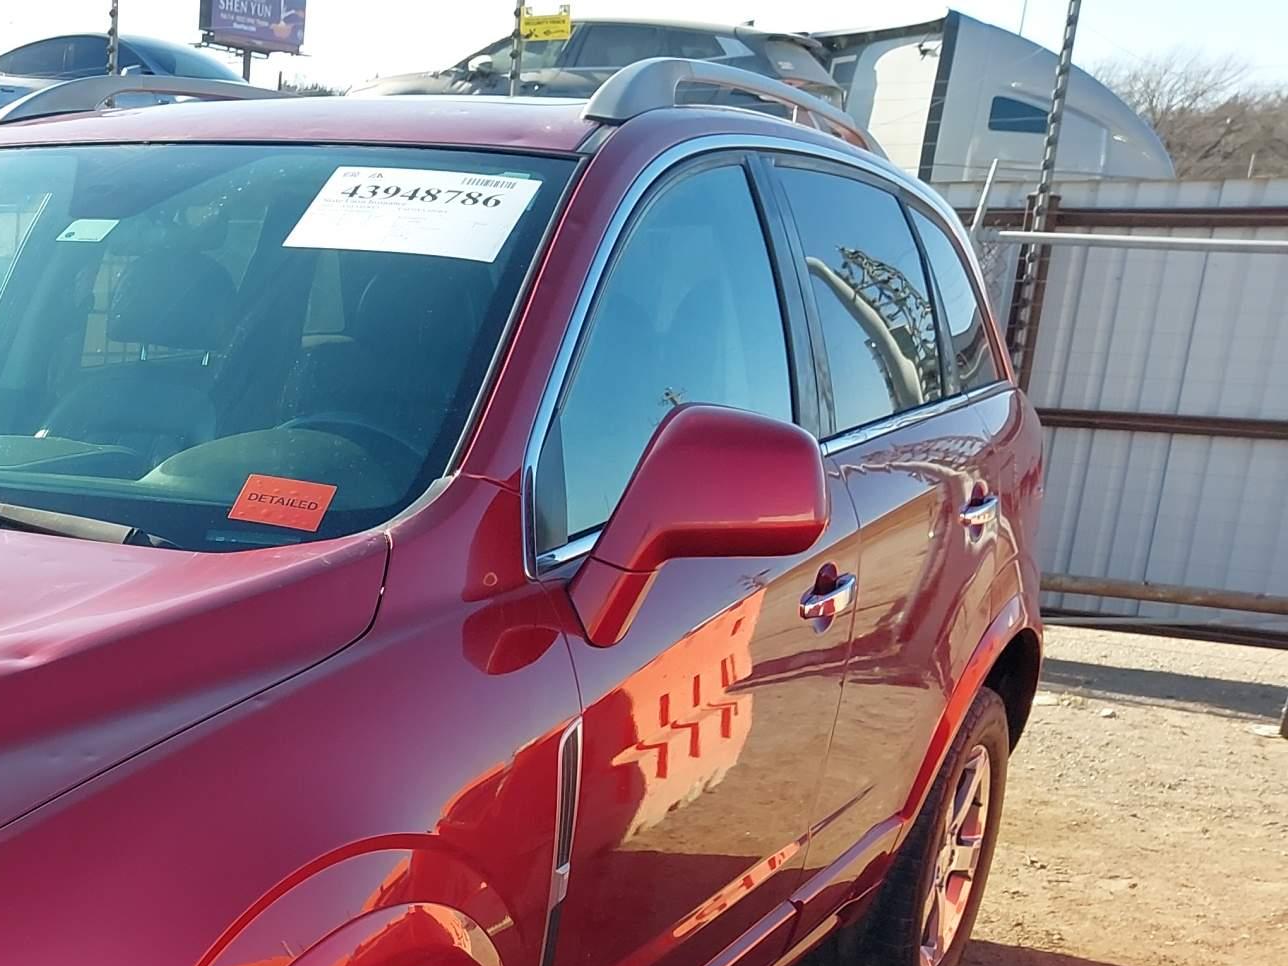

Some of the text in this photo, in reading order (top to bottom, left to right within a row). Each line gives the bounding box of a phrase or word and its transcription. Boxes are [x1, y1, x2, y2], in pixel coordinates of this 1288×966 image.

[218, 0, 272, 17] SHEN YUN
[340, 183, 505, 208] 43948786
[247, 492, 319, 511] DETAILED
